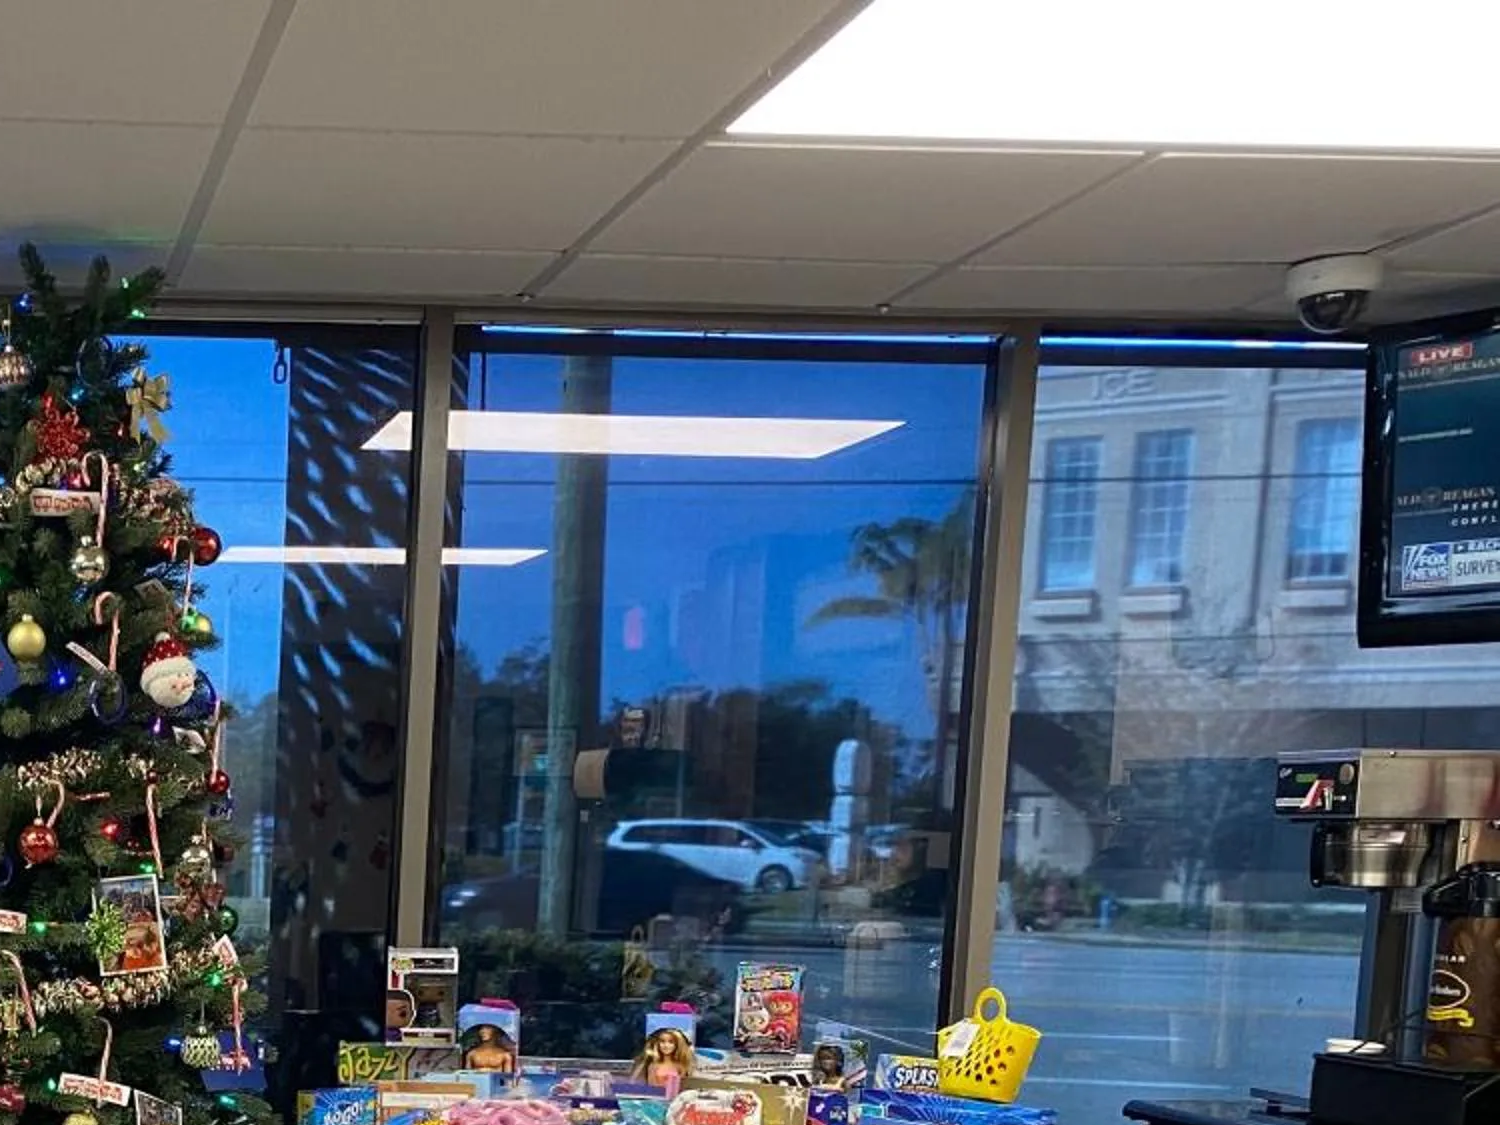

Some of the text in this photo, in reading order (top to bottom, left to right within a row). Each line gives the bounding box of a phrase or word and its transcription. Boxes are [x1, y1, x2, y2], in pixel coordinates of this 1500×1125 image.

[1419, 344, 1464, 362] LIVE
[1419, 553, 1447, 566] FOX
[1411, 566, 1448, 579] NEWS
